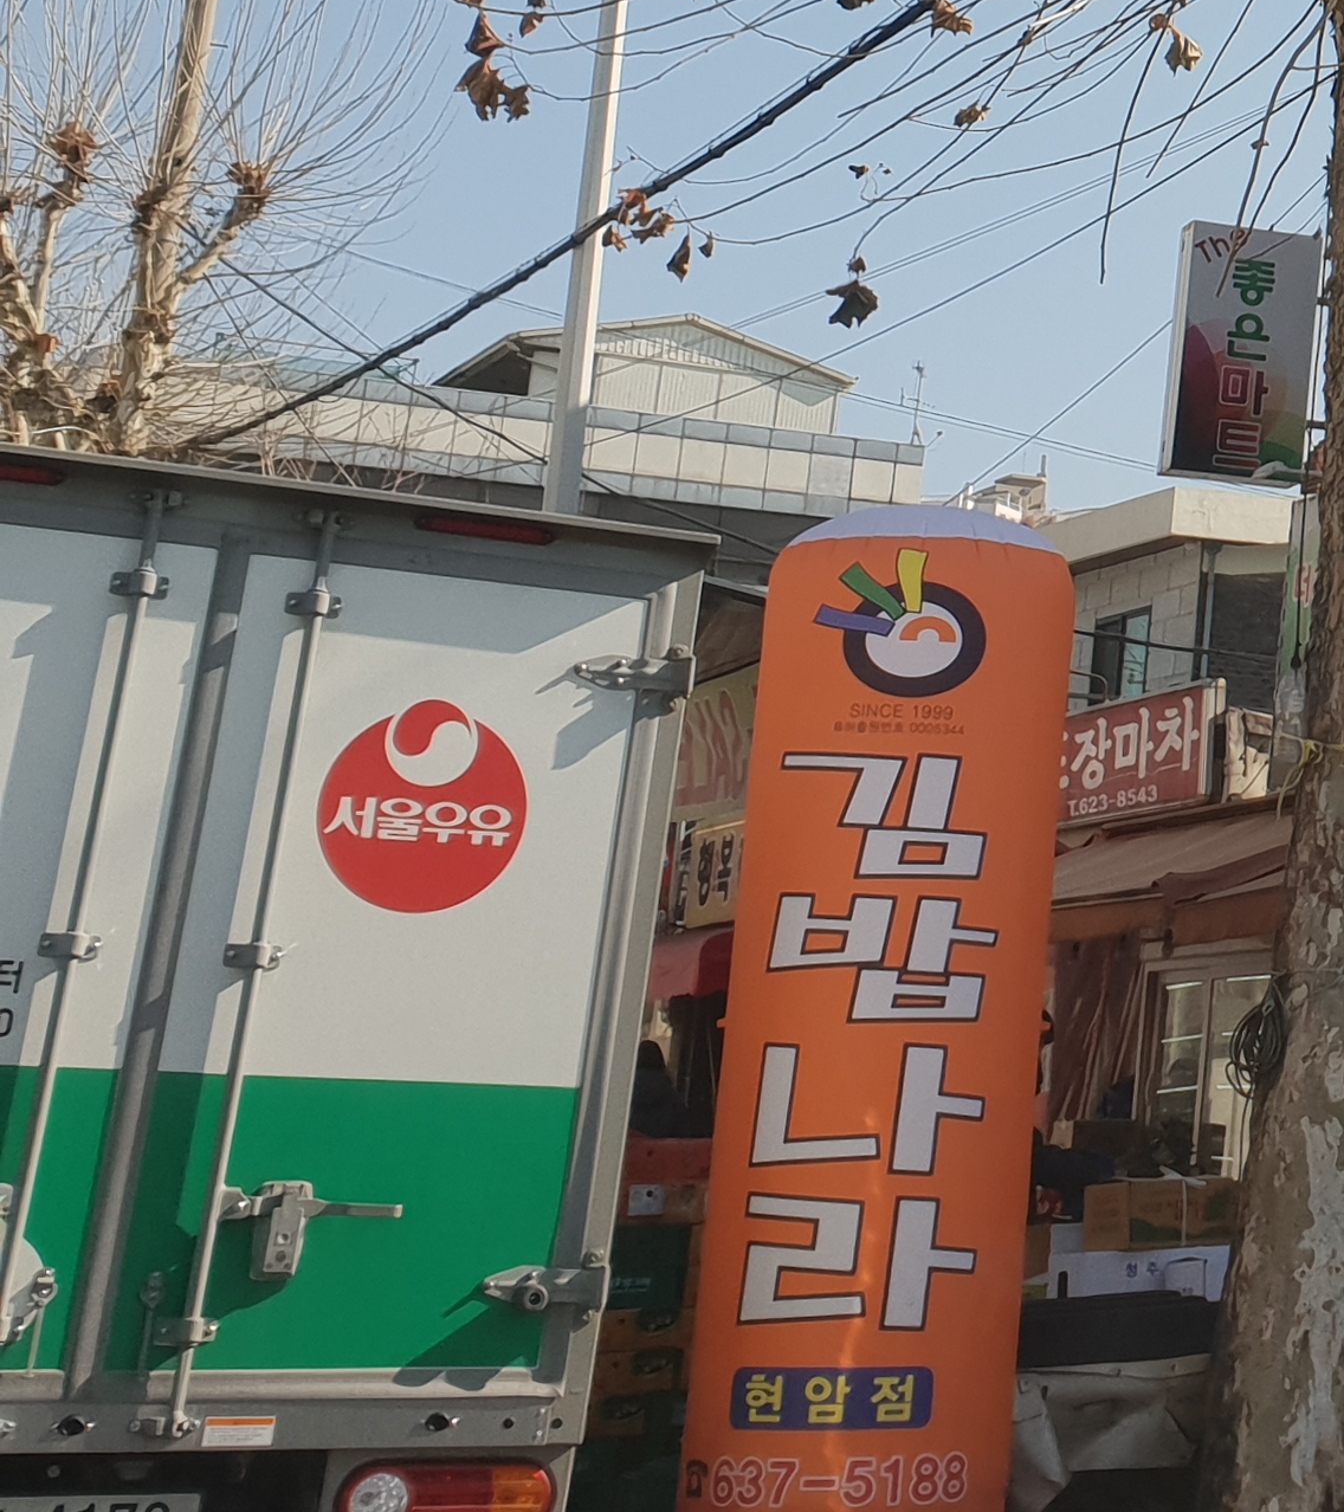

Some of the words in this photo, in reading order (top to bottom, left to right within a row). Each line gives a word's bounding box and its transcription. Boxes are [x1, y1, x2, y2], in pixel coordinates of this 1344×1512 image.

[1213, 259, 1275, 471] 좋은마트
[850, 703, 904, 718] SINCE
[913, 704, 954, 720] 1999
[1060, 695, 1201, 791] 장마차
[322, 796, 513, 847] 서울우유
[1067, 784, 1158, 817] T.623-8543
[736, 753, 999, 1332] 김밥나라
[744, 1374, 916, 1425] 현암점
[710, 1450, 968, 1508] 637-5188
